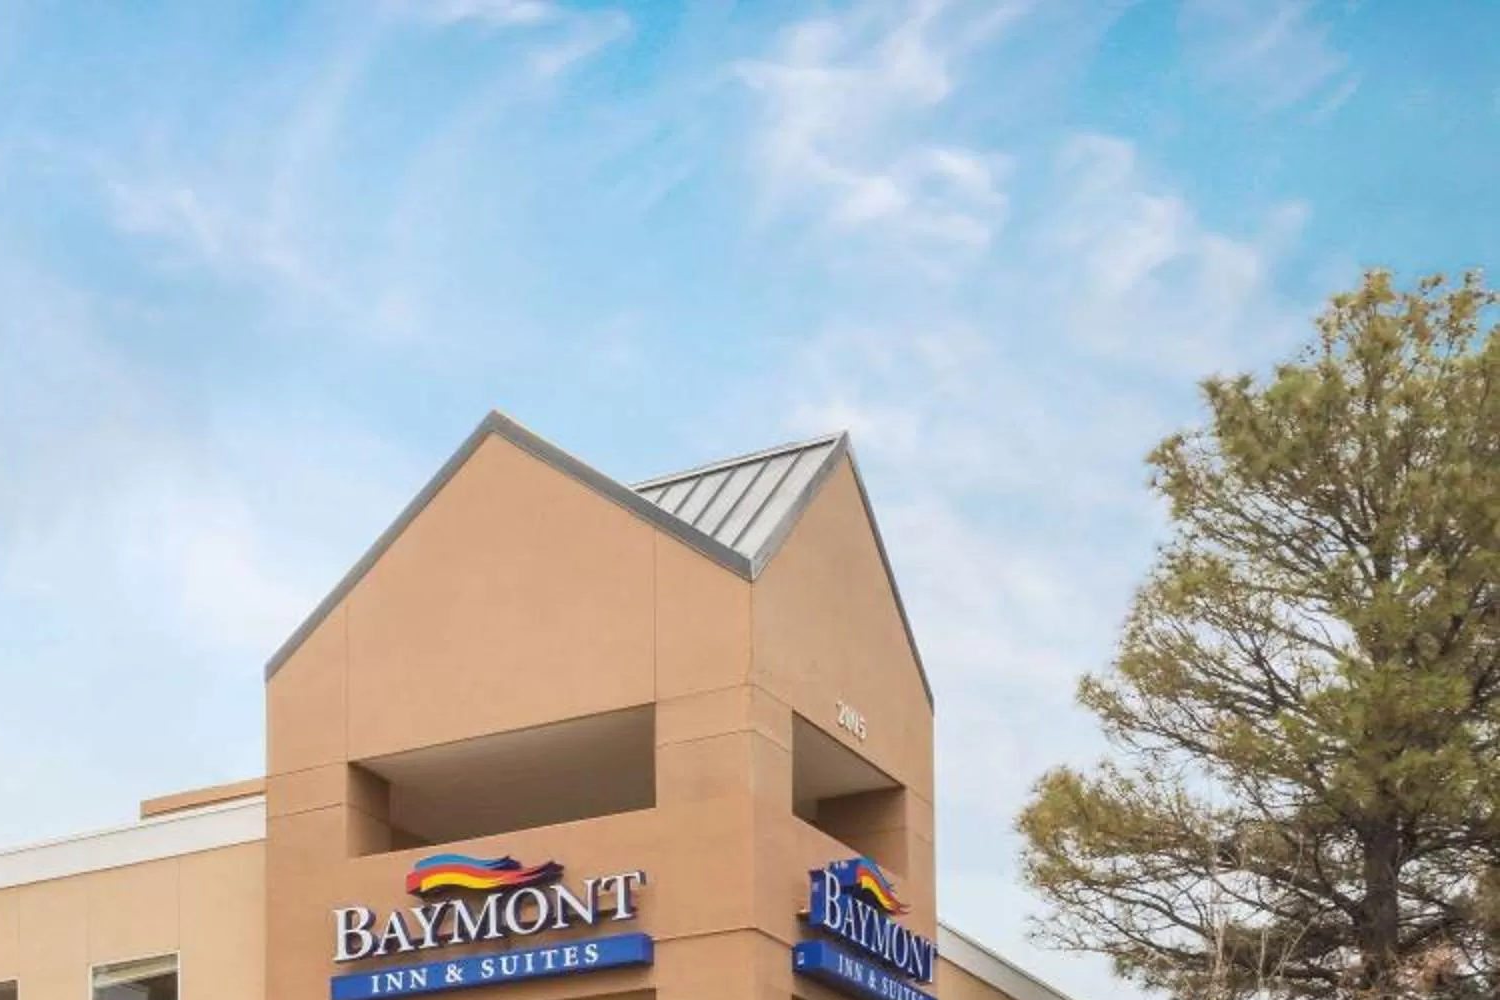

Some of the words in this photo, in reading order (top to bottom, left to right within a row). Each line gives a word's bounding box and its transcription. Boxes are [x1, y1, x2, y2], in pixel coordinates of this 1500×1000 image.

[332, 871, 644, 962] BAYMONT
[822, 869, 937, 983] BAYMONT
[370, 967, 428, 994] INN
[444, 963, 464, 983] &
[480, 943, 600, 979] SUITES
[838, 953, 862, 983] INN
[867, 968, 877, 991] &
